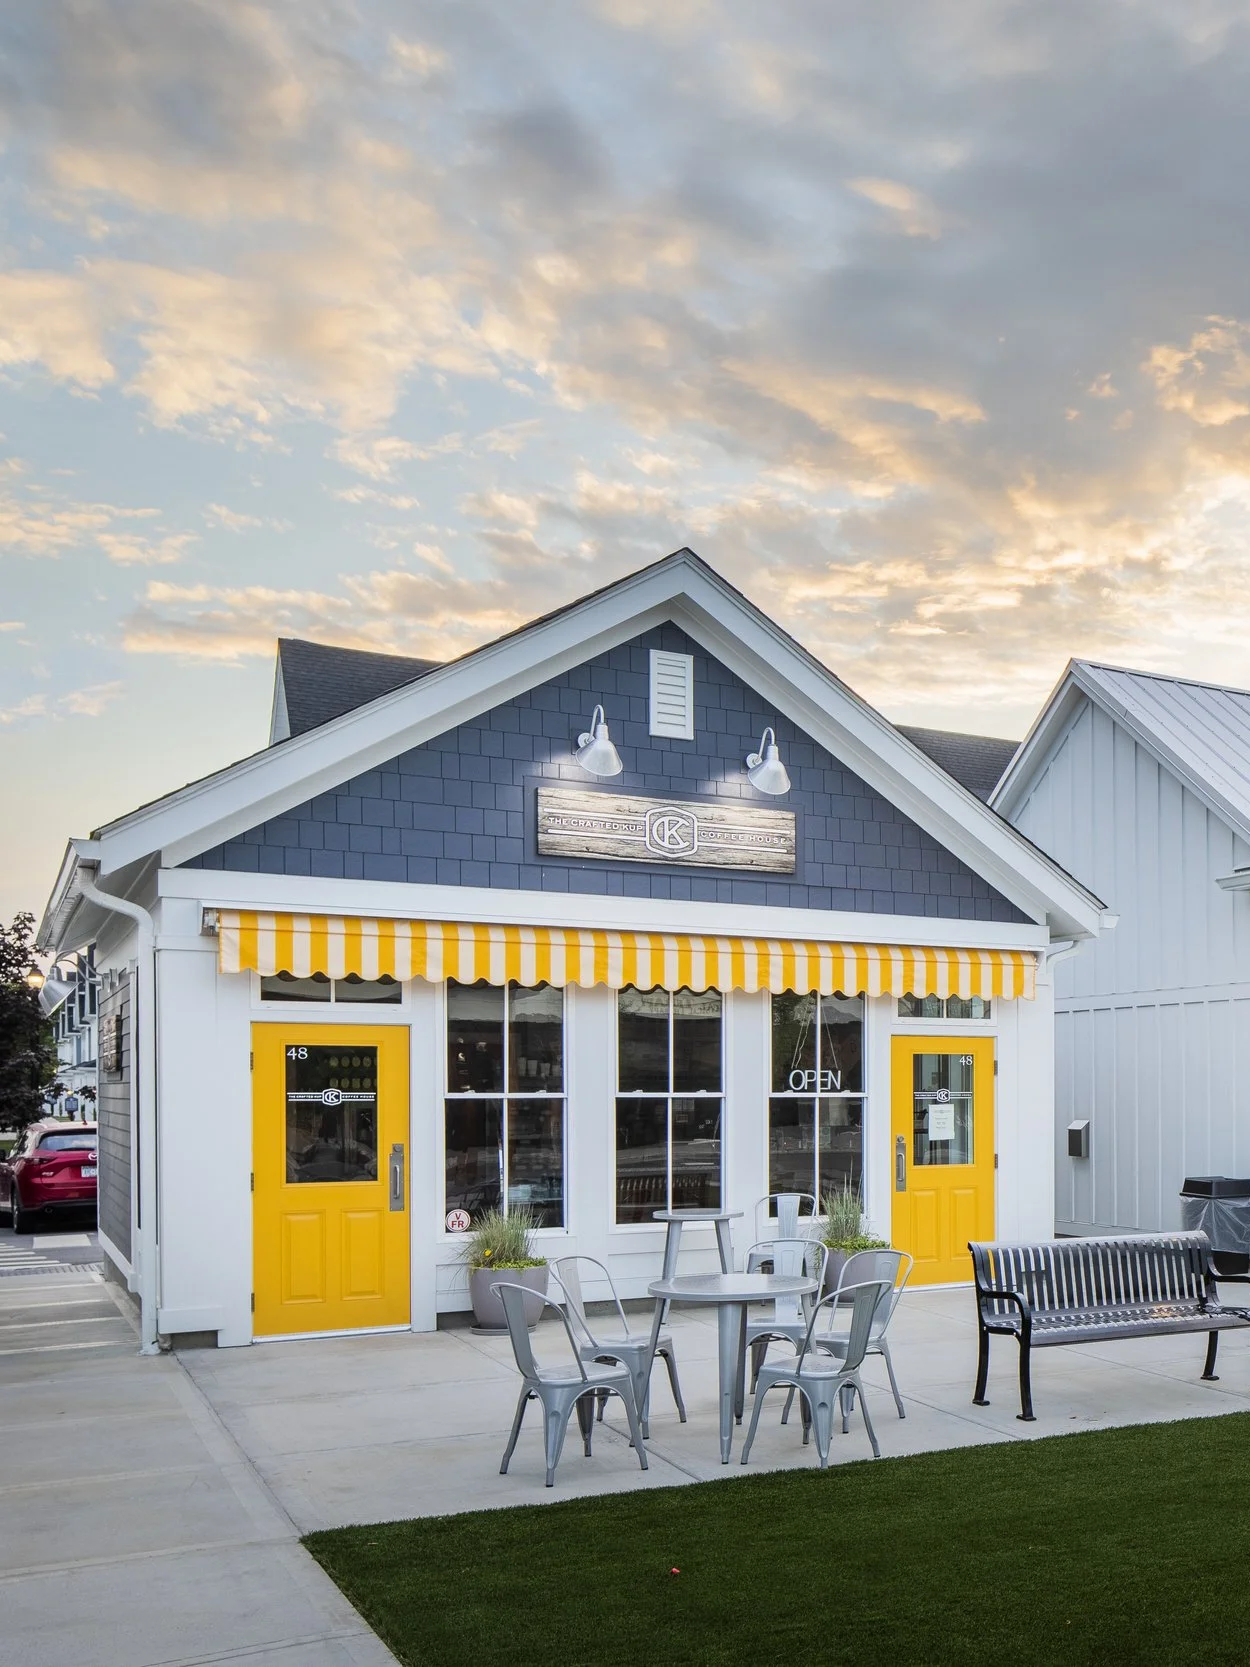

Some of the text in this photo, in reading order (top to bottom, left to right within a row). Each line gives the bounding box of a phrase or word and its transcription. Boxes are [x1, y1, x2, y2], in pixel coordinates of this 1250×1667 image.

[548, 817, 643, 832] THE CRAFTED KUP
[700, 831, 786, 845] COFFEE HOUSE
[287, 1047, 308, 1060] 48
[960, 1055, 973, 1066] 48
[789, 1069, 841, 1091] OPEN
[451, 1220, 464, 1228] FR
